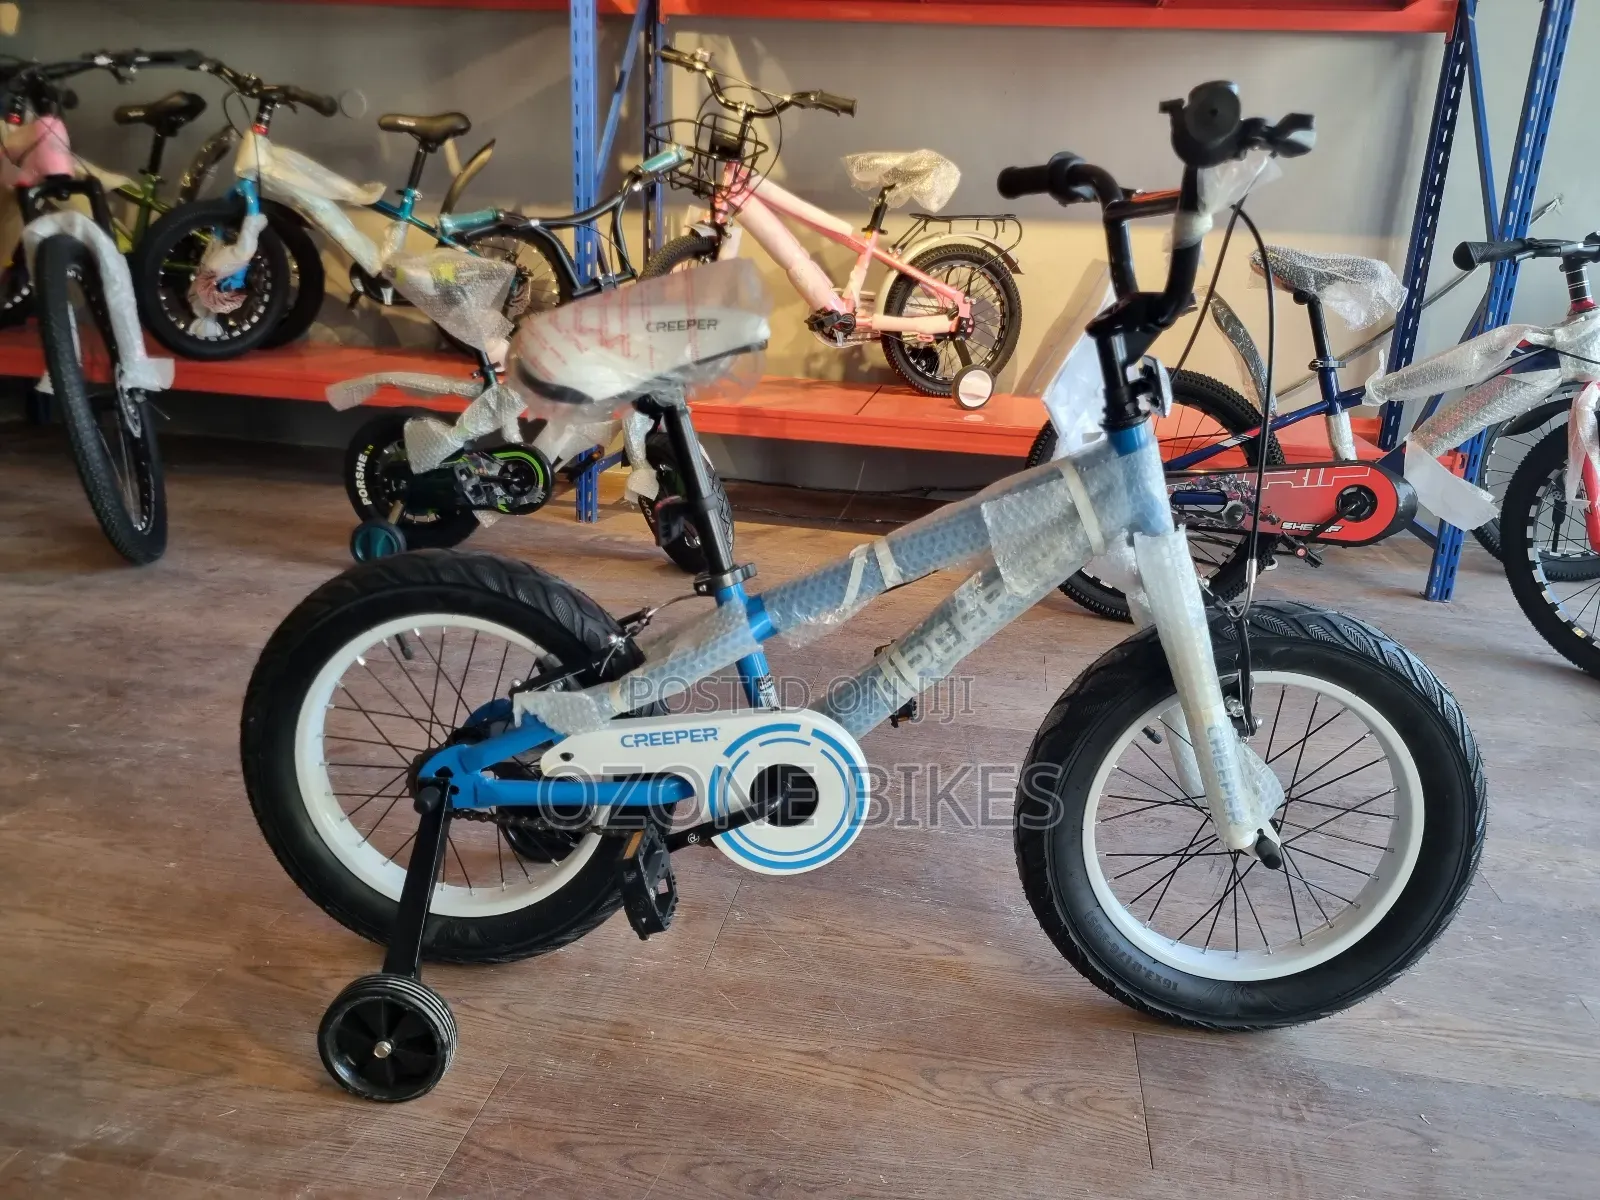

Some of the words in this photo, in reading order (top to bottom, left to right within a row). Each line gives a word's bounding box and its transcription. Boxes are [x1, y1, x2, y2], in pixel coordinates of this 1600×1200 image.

[645, 318, 719, 333] CREEPER
[355, 453, 372, 506] PORSHE
[1281, 521, 1344, 533] SHEF
[620, 727, 719, 748] CREEPER
